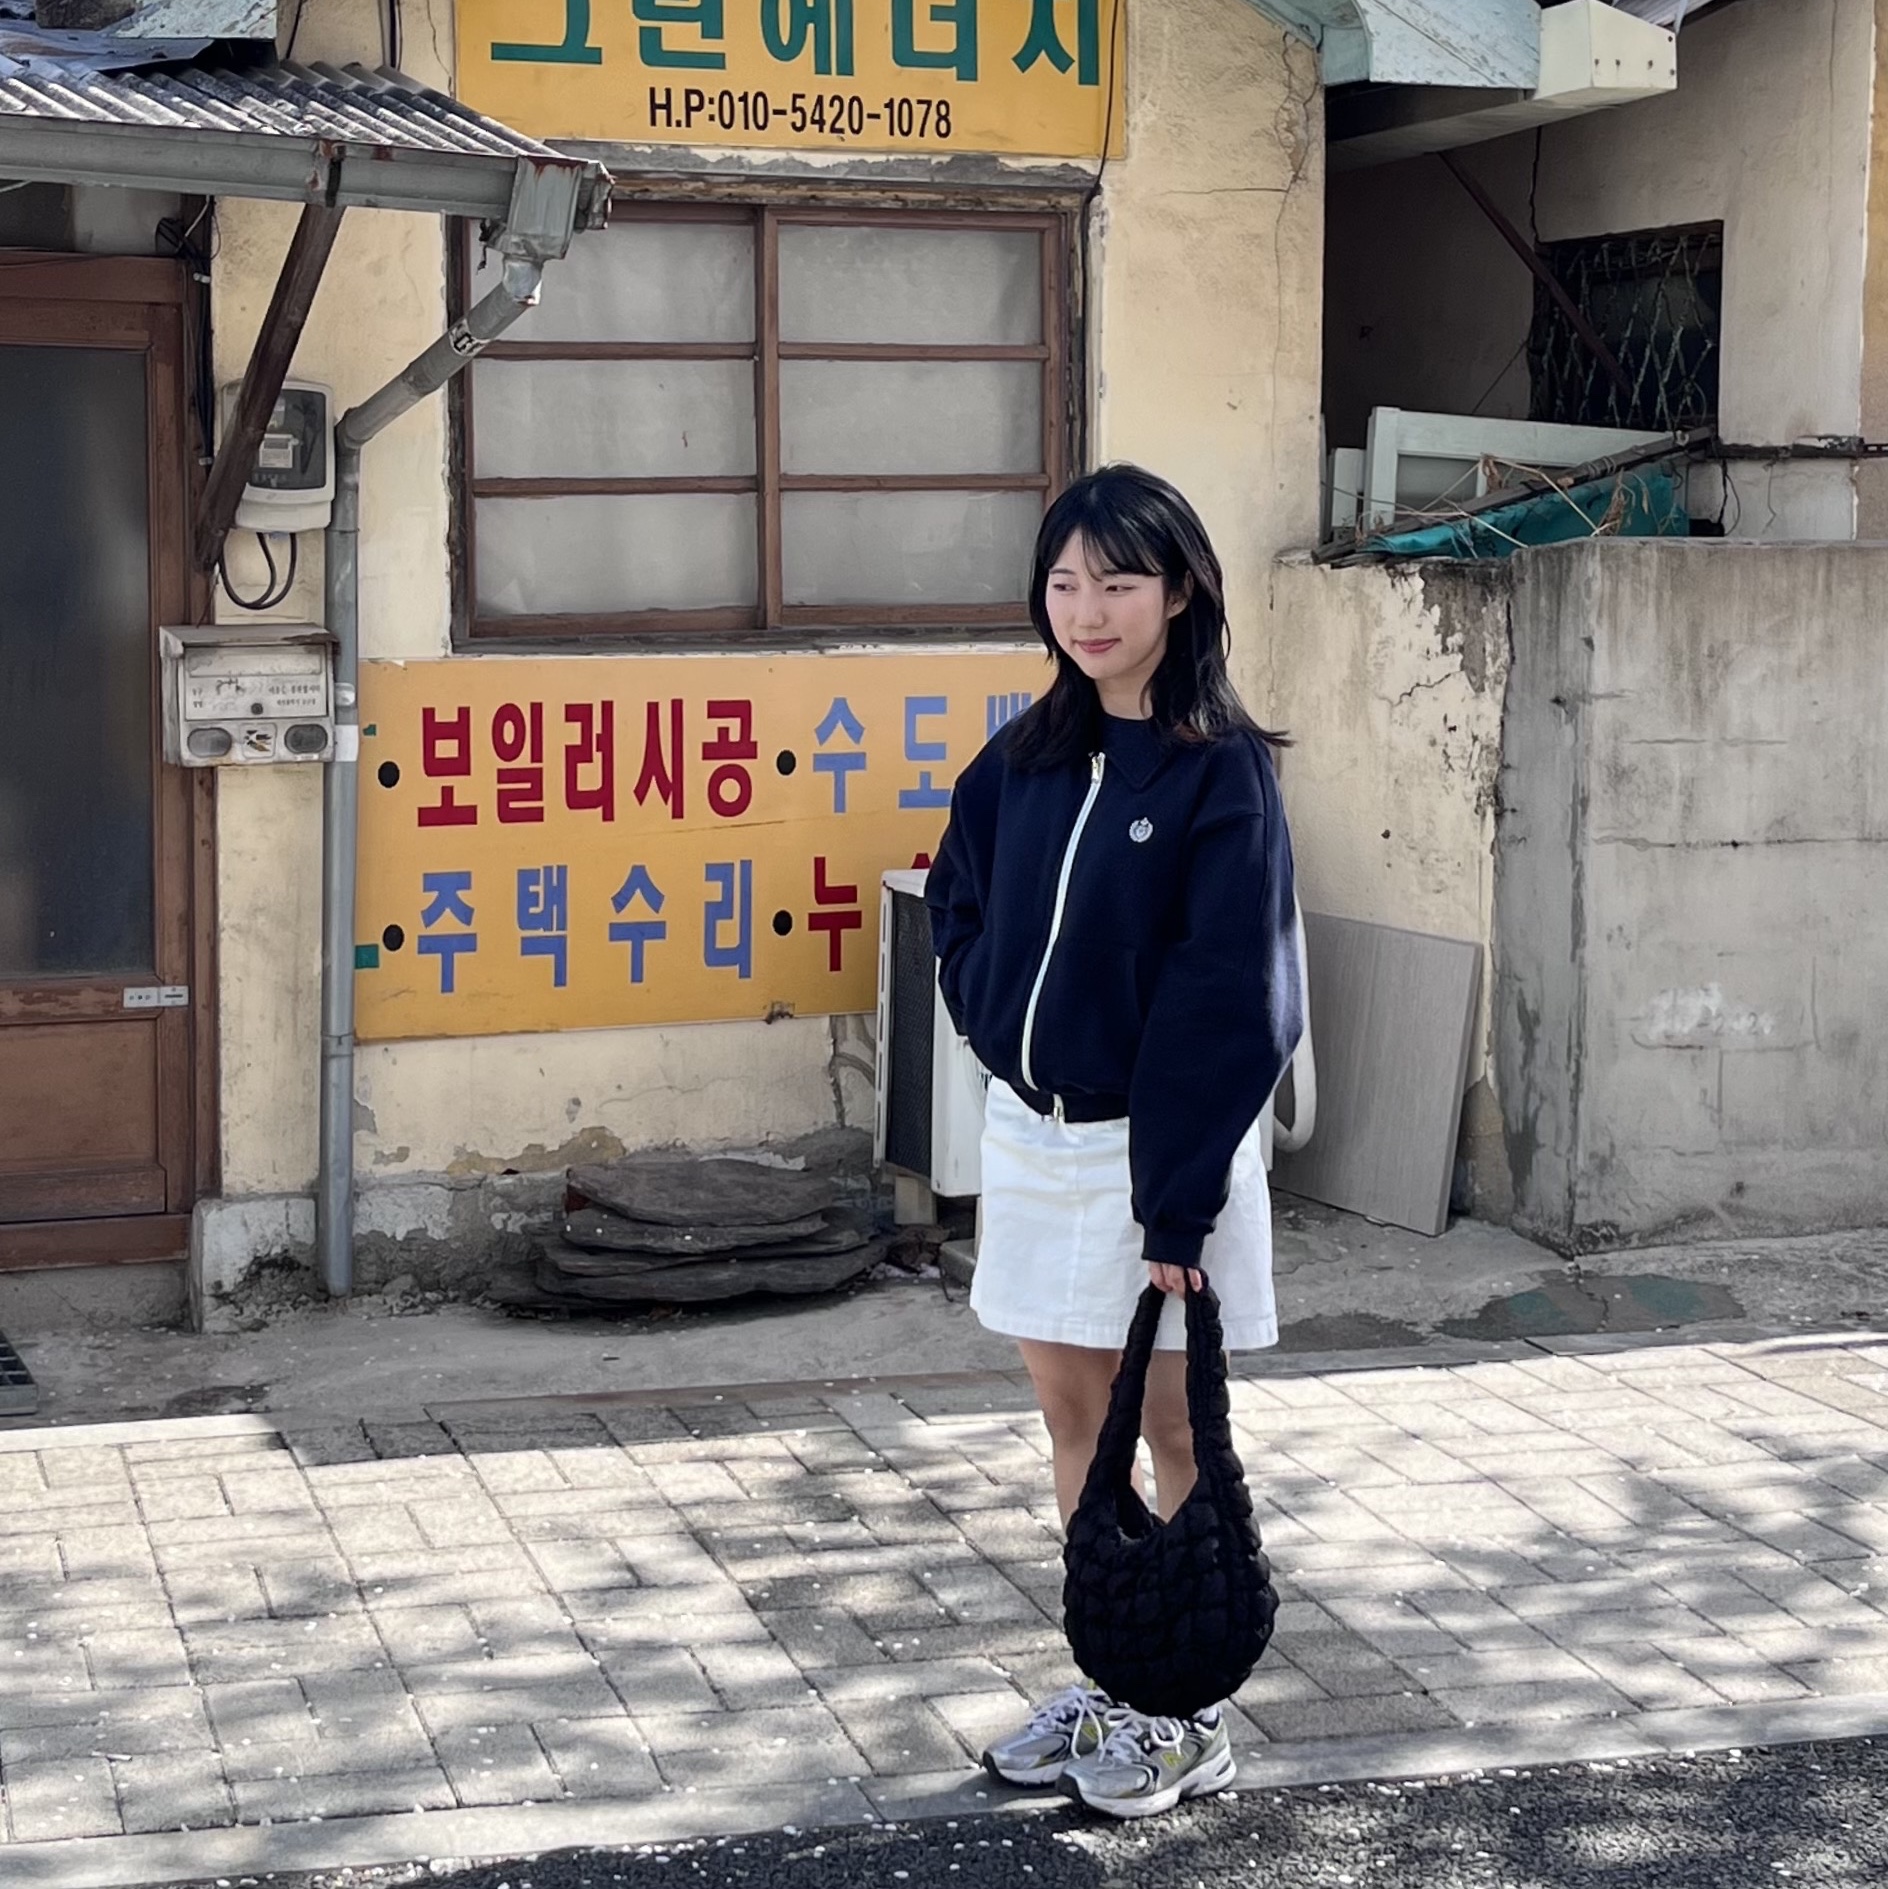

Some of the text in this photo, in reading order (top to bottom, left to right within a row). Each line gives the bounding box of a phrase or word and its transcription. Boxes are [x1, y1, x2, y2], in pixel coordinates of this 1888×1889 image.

[649, 86, 951, 138] H.P:010-5420-1078
[417, 699, 757, 827] 보일러시공
[417, 859, 752, 993] 주택수리
